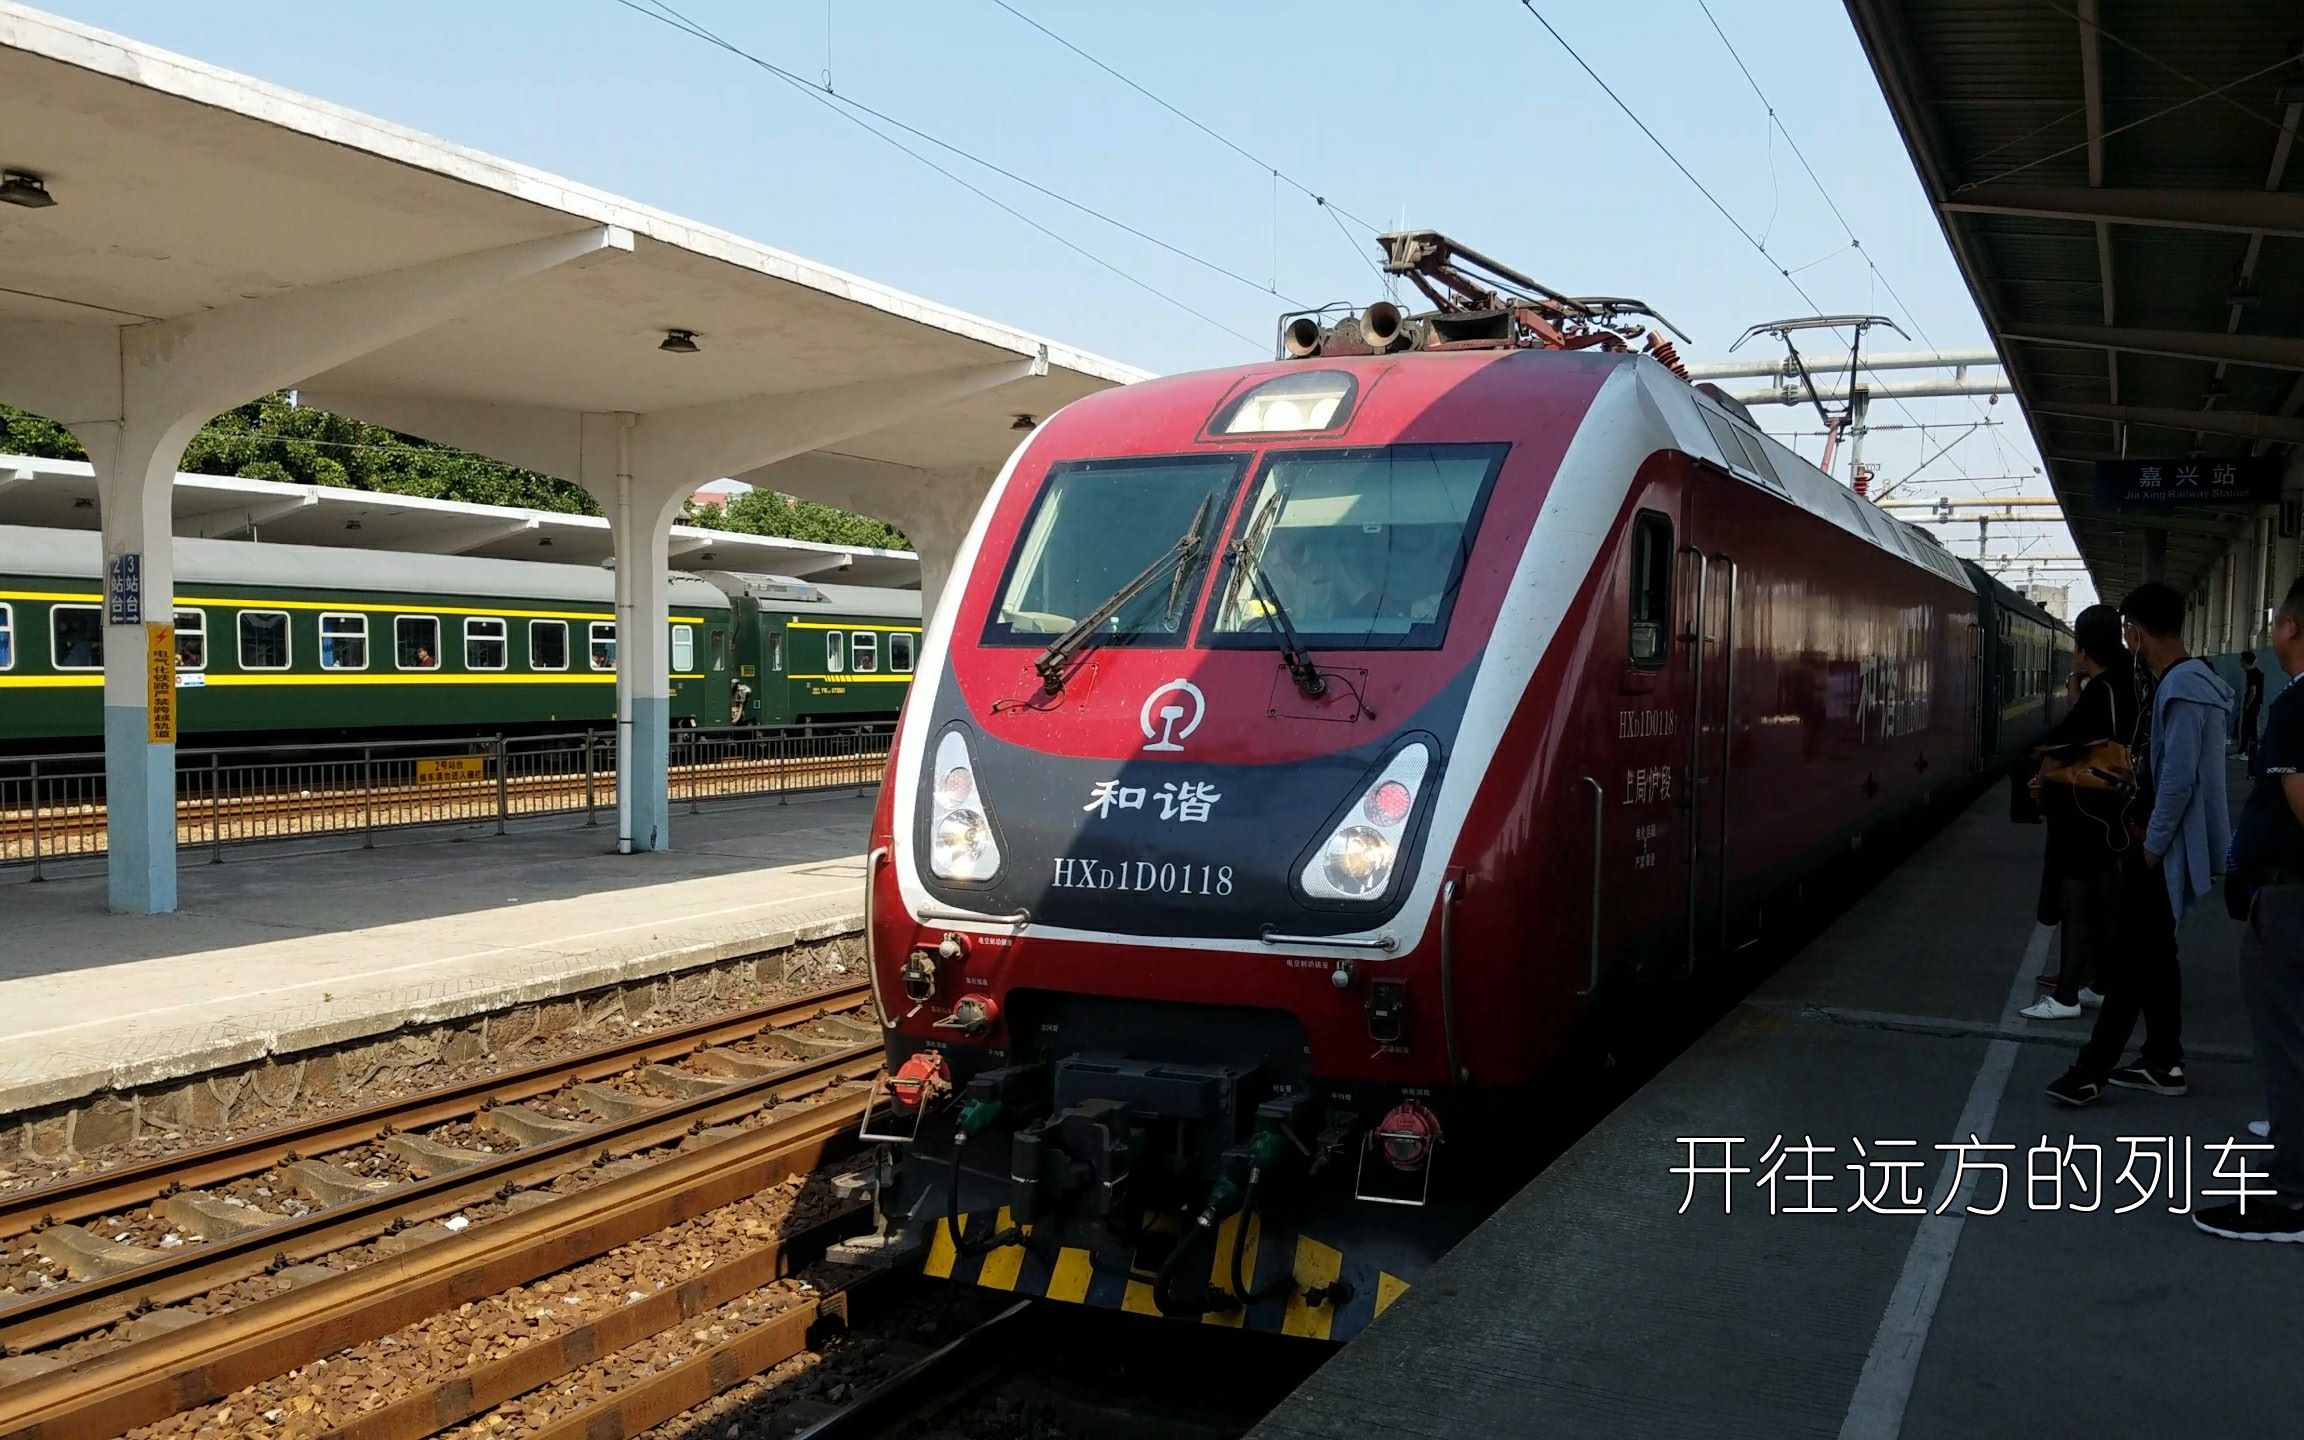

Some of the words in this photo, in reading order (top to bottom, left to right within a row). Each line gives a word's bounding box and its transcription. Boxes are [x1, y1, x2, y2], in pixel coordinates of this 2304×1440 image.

[2124, 490, 2140, 500] Jia
[2143, 490, 2166, 502] Xing
[2168, 489, 2210, 501] Railway
[2212, 488, 2250, 499] Station
[2139, 464, 2238, 487] 嘉兴站
[126, 555, 140, 613] 3站台
[1083, 779, 1222, 823] 和谐
[1622, 764, 1672, 805] 上局沪段
[1052, 858, 1234, 896] HXD1D0118
